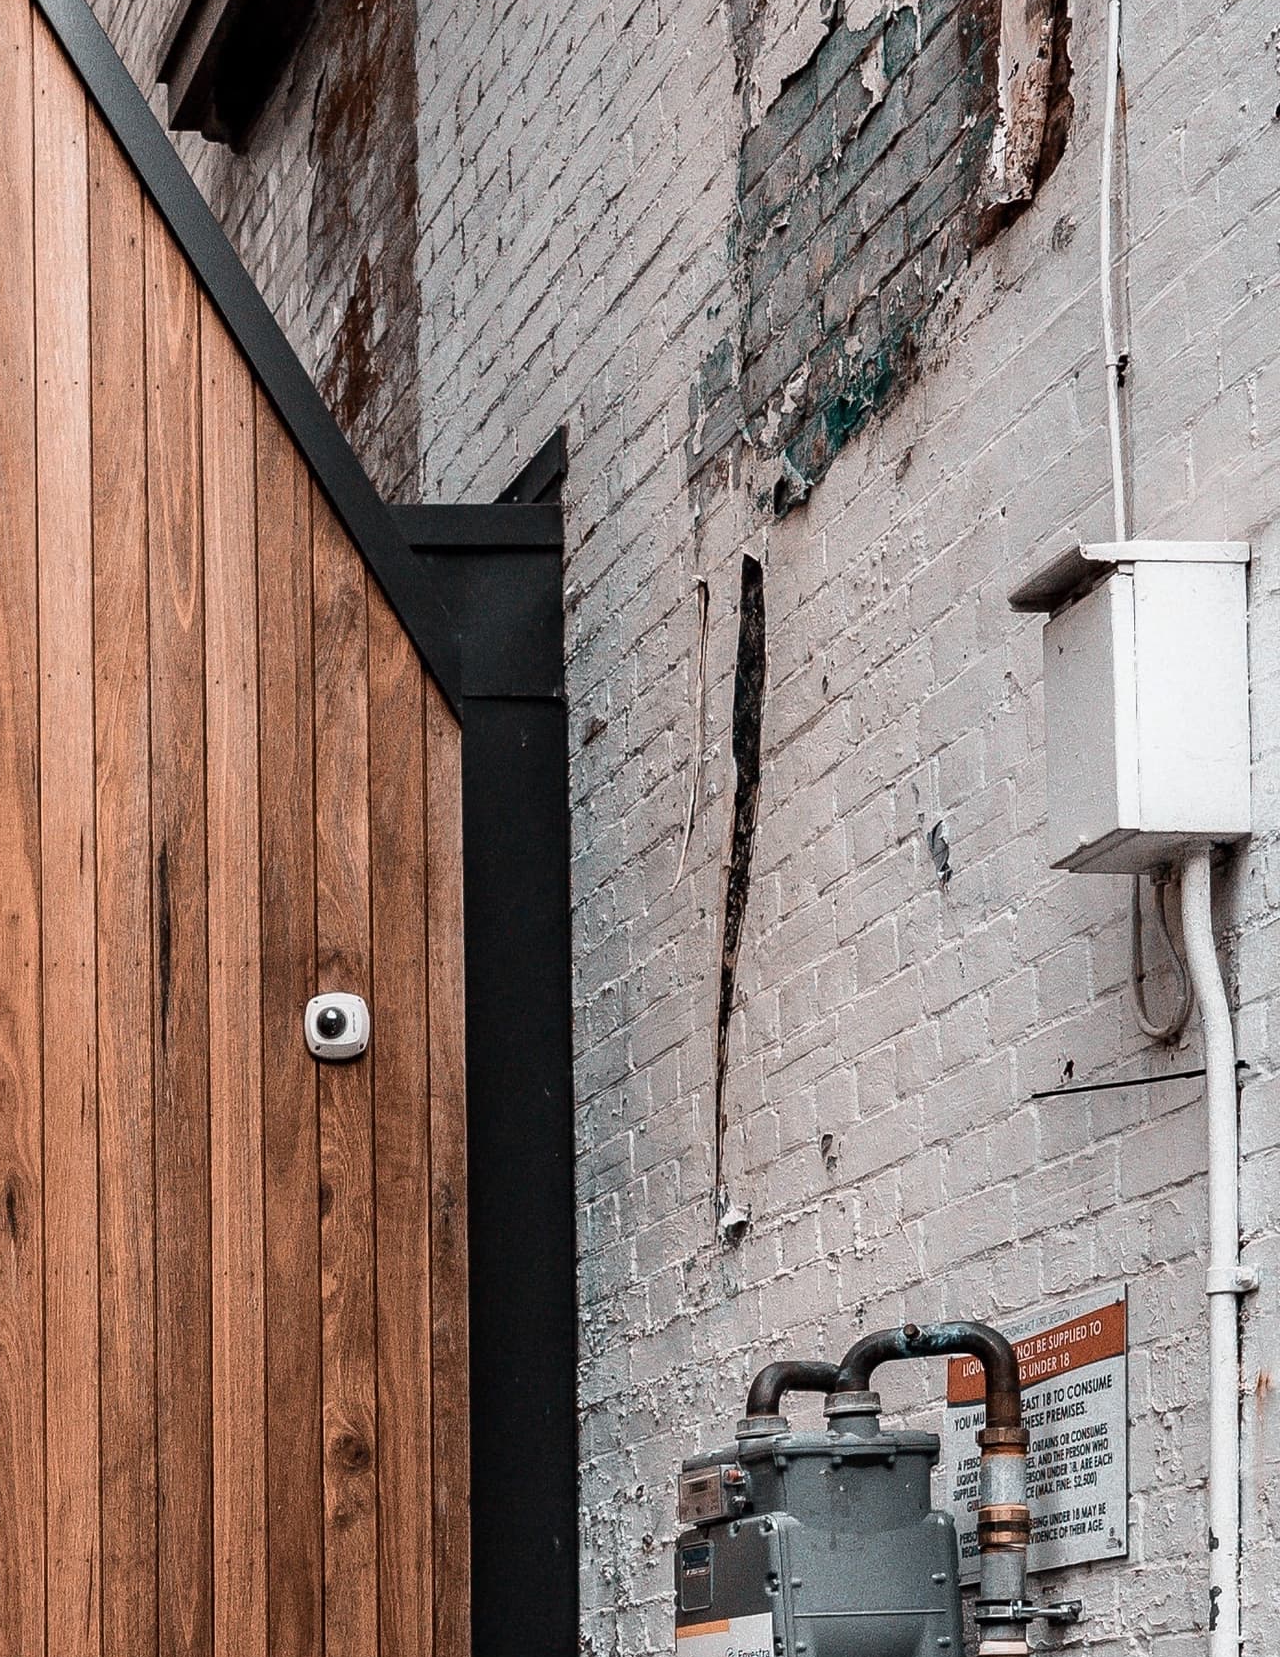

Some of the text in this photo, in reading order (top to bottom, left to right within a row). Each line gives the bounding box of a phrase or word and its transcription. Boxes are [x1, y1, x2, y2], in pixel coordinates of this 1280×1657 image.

[1016, 1342, 1035, 1360] NOT
[1037, 1338, 1047, 1353] BE
[1048, 1325, 1087, 1350] SUPPLIED
[1089, 1320, 1102, 1336] TO
[1029, 1356, 1057, 1377] UNDER
[1059, 1352, 1070, 1368] 18
[954, 1415, 971, 1431] YOU
[1042, 1392, 1052, 1407] 18
[1053, 1388, 1065, 1403] TO
[1066, 1374, 1113, 1397] CONSUME
[1046, 1401, 1087, 1424] PREMISES.
[1070, 1423, 1108, 1442] CONSUMES
[1038, 1452, 1052, 1465] AND
[1053, 1449, 1064, 1461] THE
[1065, 1441, 1090, 1459] PERSON
[1092, 1438, 1109, 1453] WHO
[1094, 1452, 1113, 1467] EACH
[1081, 1504, 1097, 1518] MAY
